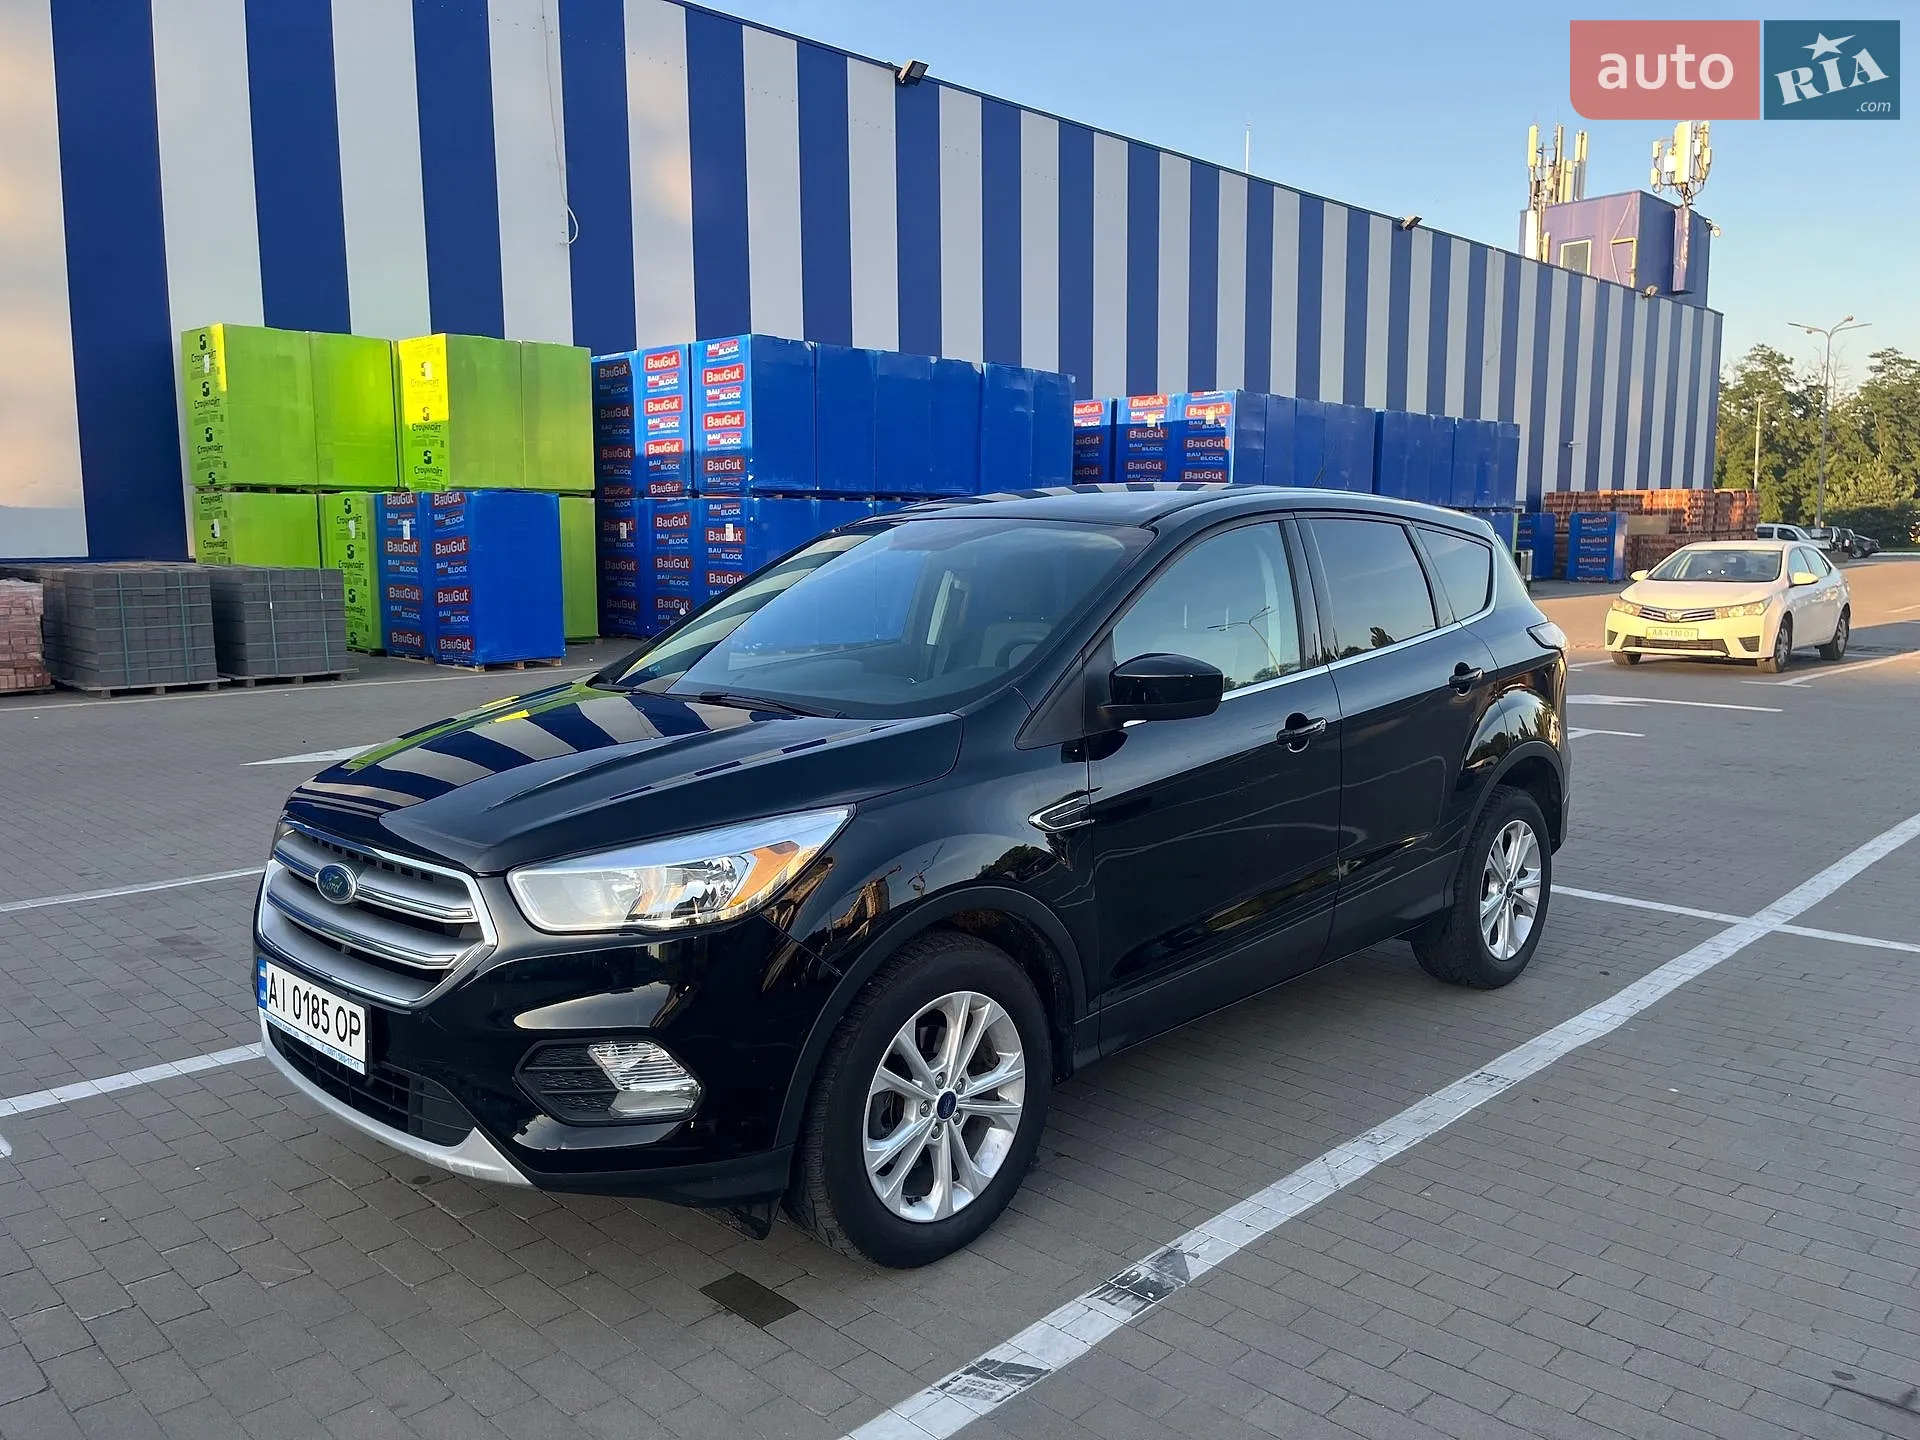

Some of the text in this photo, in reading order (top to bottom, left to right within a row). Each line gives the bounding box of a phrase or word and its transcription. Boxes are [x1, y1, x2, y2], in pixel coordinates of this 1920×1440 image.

[707, 343, 720, 351] BAU
[719, 344, 739, 356] BLOCK
[647, 355, 678, 369] BauGut
[600, 364, 628, 378] BauGut
[706, 367, 741, 382] BauGut
[658, 377, 678, 387] BLOCK
[719, 391, 741, 400] BLOCK
[647, 399, 679, 413] BauGut
[1131, 397, 1164, 407] BauGut
[600, 406, 630, 419] BauGut
[647, 417, 660, 425] BAU
[659, 421, 679, 429] BLOCK
[707, 413, 741, 427] BauGut
[1129, 430, 1164, 438] BauGut
[720, 437, 741, 445] BLOCK
[1186, 439, 1225, 448] BauGut
[602, 447, 631, 458] BauGut
[648, 442, 680, 455] BauGut
[648, 459, 661, 467] BAU
[660, 463, 680, 471] BLOCK
[707, 459, 741, 471] BauGut
[1127, 461, 1162, 470] BauGut
[1184, 471, 1222, 479] BauGut
[650, 483, 679, 494] BauGut
[386, 493, 414, 505] BauGut
[434, 492, 461, 505] BauGut
[720, 508, 741, 516] BLOCK
[445, 515, 464, 525] BLOCK
[656, 514, 688, 527] BauGut
[708, 530, 742, 541] Bauut
[387, 541, 417, 553] BauGut
[435, 540, 466, 554] BauGut
[400, 565, 418, 573] BLOCK
[604, 560, 635, 571] BauGut
[656, 558, 689, 569] BauGut
[448, 565, 467, 574] BLOCK
[389, 587, 420, 600] BauGut
[437, 589, 468, 603] BauGut
[606, 599, 637, 610] BauGut
[657, 598, 689, 611] BauGut
[402, 611, 420, 620] BLOCK
[450, 615, 469, 623] BLOCK
[391, 632, 421, 646] BauGut
[440, 638, 471, 651] BauGut
[268, 972, 286, 1012] AI
[293, 985, 329, 1034] 0185
[336, 1005, 361, 1047] OP
